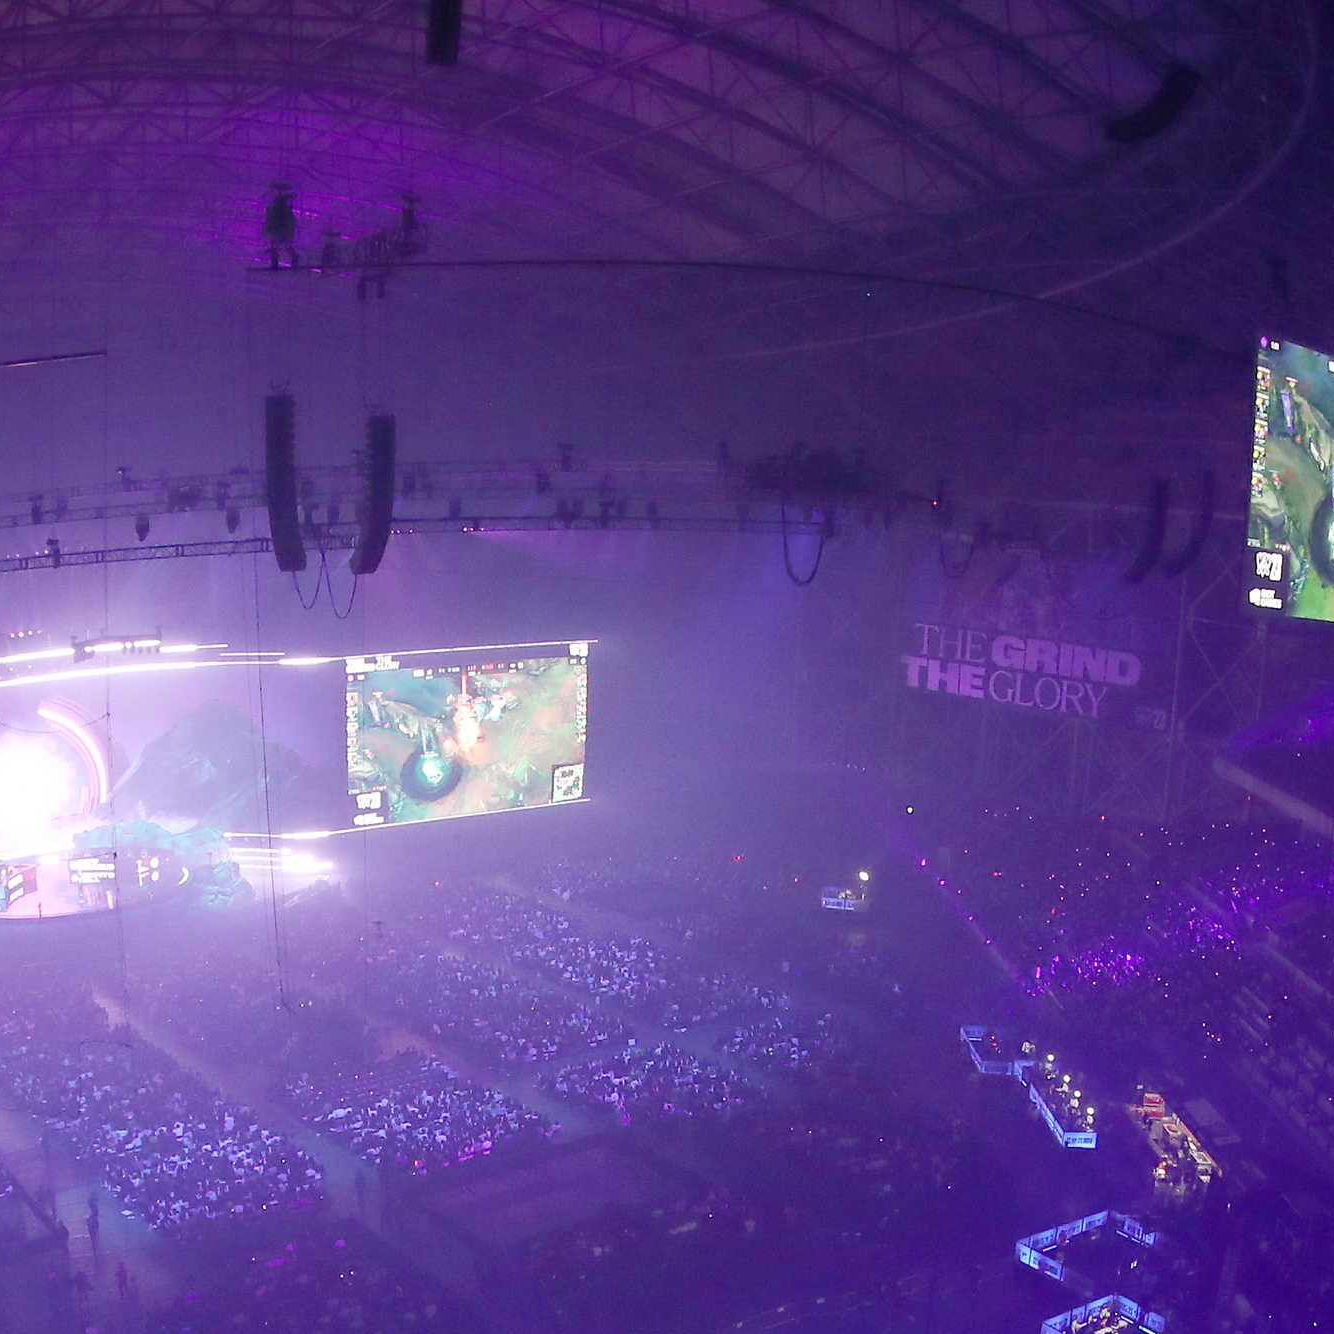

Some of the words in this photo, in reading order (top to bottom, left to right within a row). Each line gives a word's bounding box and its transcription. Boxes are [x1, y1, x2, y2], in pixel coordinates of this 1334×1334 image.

[915, 623, 988, 662] THE
[991, 635, 1141, 686] GRIND
[901, 655, 986, 699] THE
[989, 671, 1108, 718] GLORY
